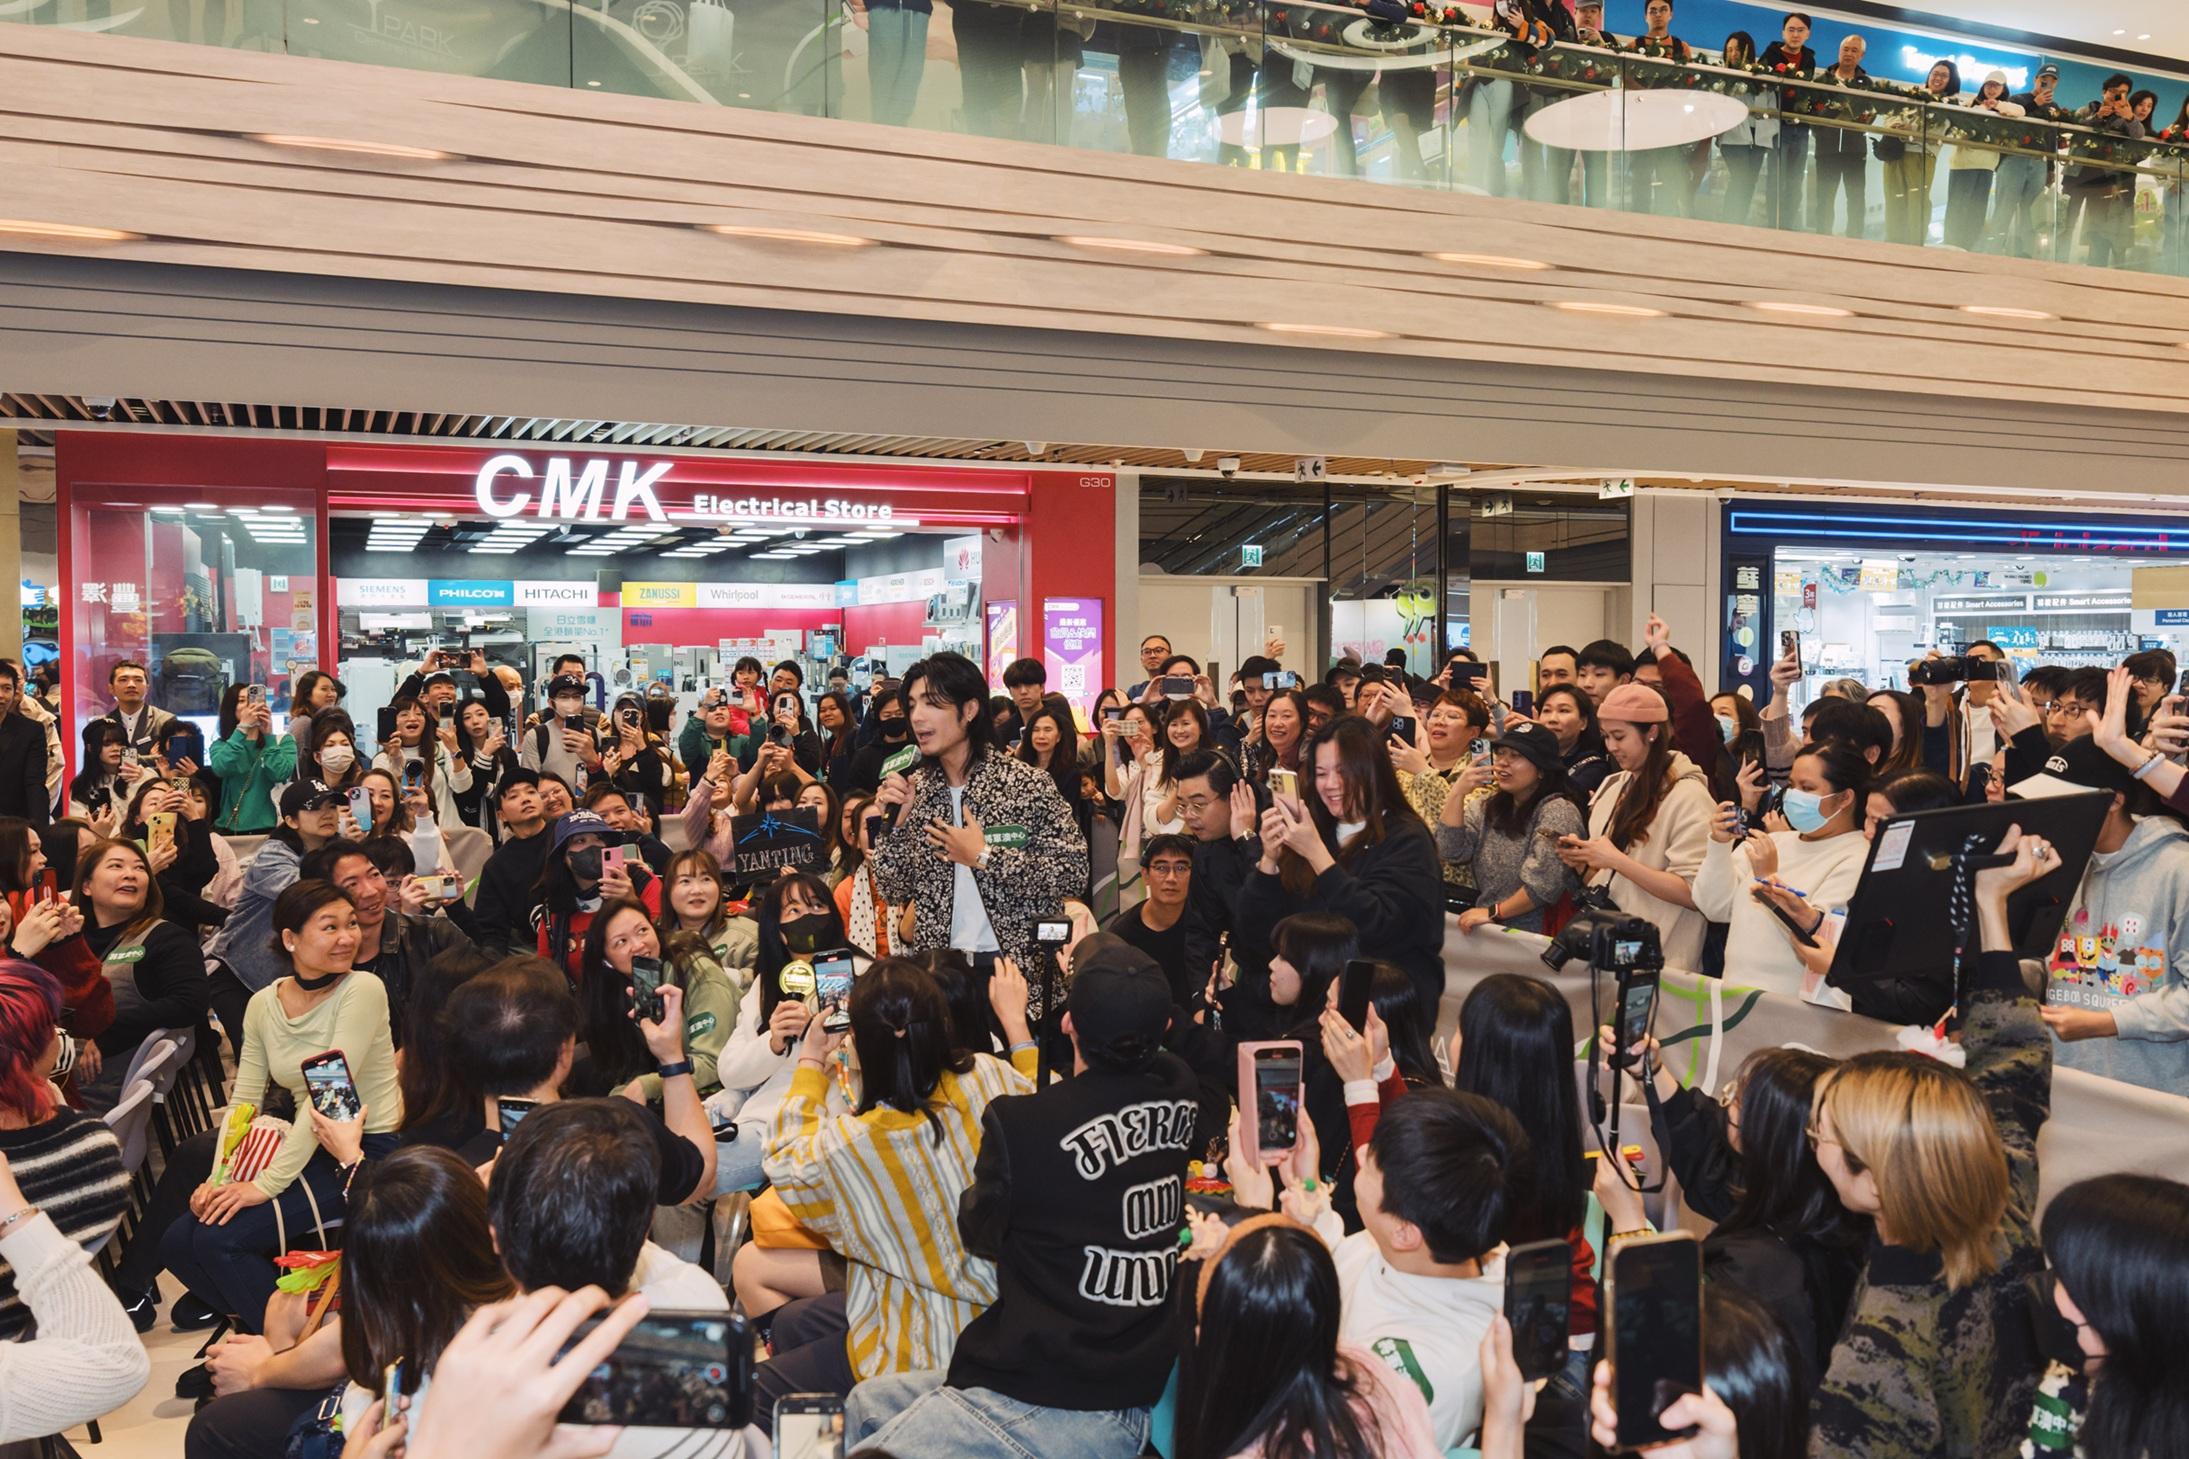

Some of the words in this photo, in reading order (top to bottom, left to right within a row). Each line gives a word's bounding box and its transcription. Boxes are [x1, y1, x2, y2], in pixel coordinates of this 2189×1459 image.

[475, 454, 674, 522] CMK
[1079, 477, 1111, 488] G30
[693, 494, 819, 517] Electrical
[825, 499, 893, 519] Store
[360, 585, 405, 593] SIEMENS
[525, 589, 588, 600] HITACHI
[640, 588, 680, 599] ZANUSSI
[711, 589, 759, 602] Whirlpool
[1965, 600, 1984, 609] Smart
[1985, 599, 2024, 608] Accessories
[2068, 597, 2090, 606] Smart
[737, 843, 815, 873] YANTING
